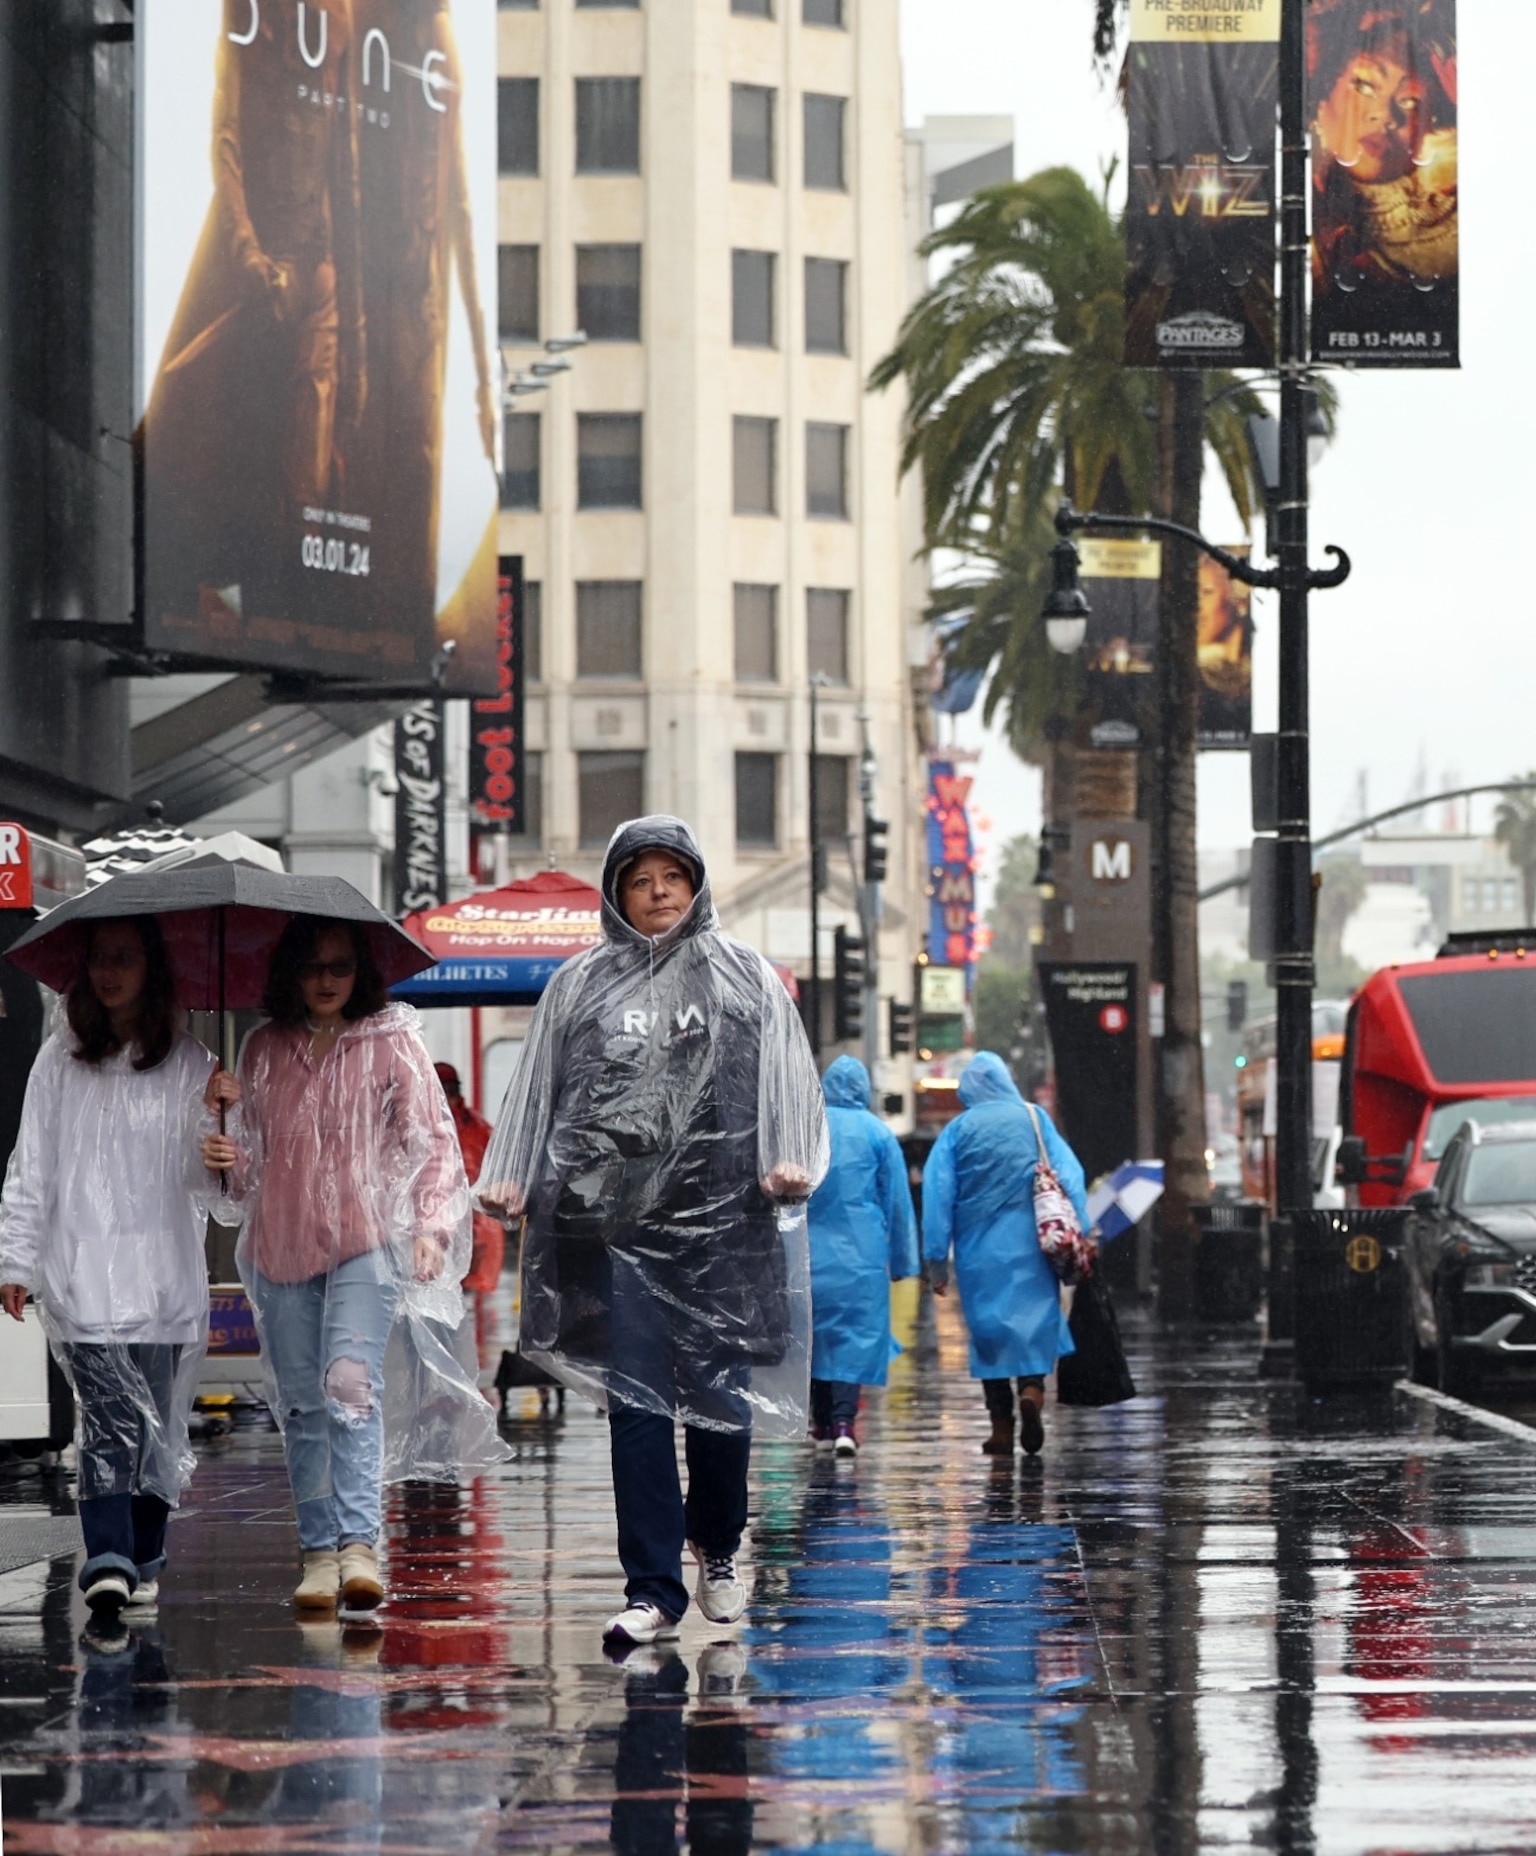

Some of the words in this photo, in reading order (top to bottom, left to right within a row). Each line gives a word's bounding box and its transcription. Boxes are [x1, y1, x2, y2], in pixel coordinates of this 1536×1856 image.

[1166, 16, 1242, 32] PREMIERE
[1133, 164, 1270, 217] WIZ
[1159, 326, 1241, 342] PANTAGES
[1329, 332, 1359, 347] FEB
[1432, 332, 1441, 347] 3
[302, 535, 370, 577] 03.01.24
[933, 775, 973, 862] WAX
[398, 771, 441, 914] DARKNES
[1092, 842, 1131, 878] M
[450, 934, 492, 946] Hop
[496, 934, 527, 945] On
[532, 934, 574, 946] Hop
[1067, 986, 1128, 1002] Highland
[1106, 1008, 1122, 1028] B
